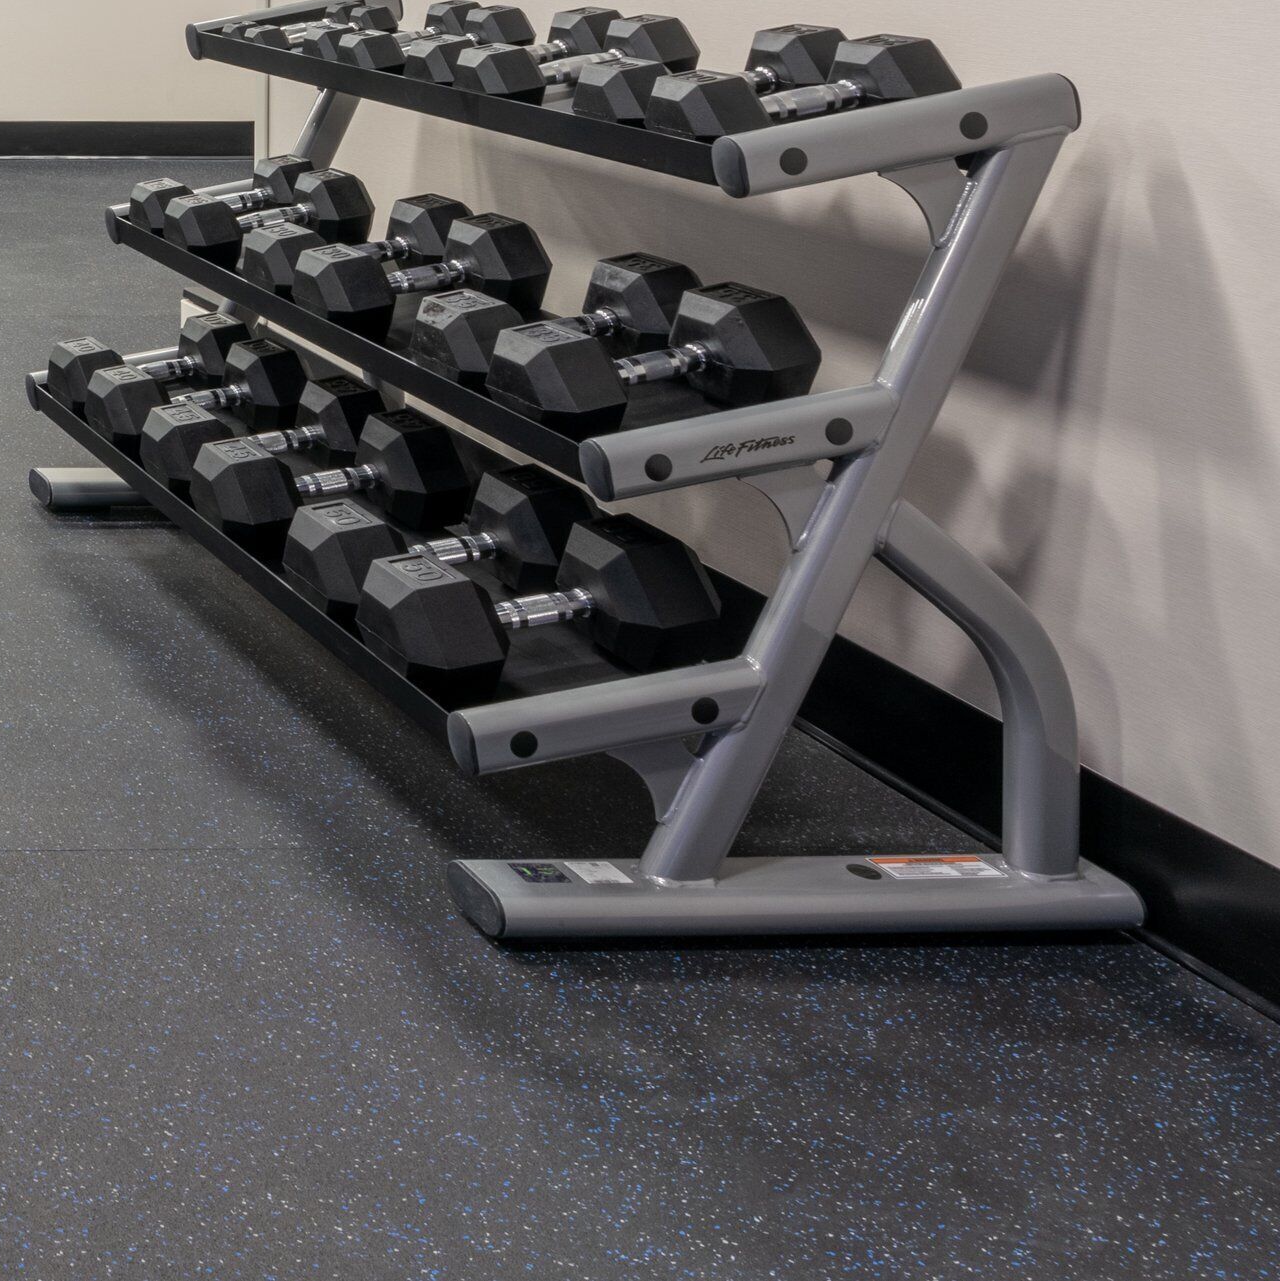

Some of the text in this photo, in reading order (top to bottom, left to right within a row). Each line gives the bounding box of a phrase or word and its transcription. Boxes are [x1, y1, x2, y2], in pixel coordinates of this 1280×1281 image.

[271, 226, 298, 237] 30
[322, 249, 351, 259] 30
[73, 342, 96, 353] 40
[112, 370, 137, 381] 40
[170, 408, 200, 422] 45
[224, 444, 257, 459] 45
[324, 509, 361, 526] 50
[402, 561, 444, 582] 50
